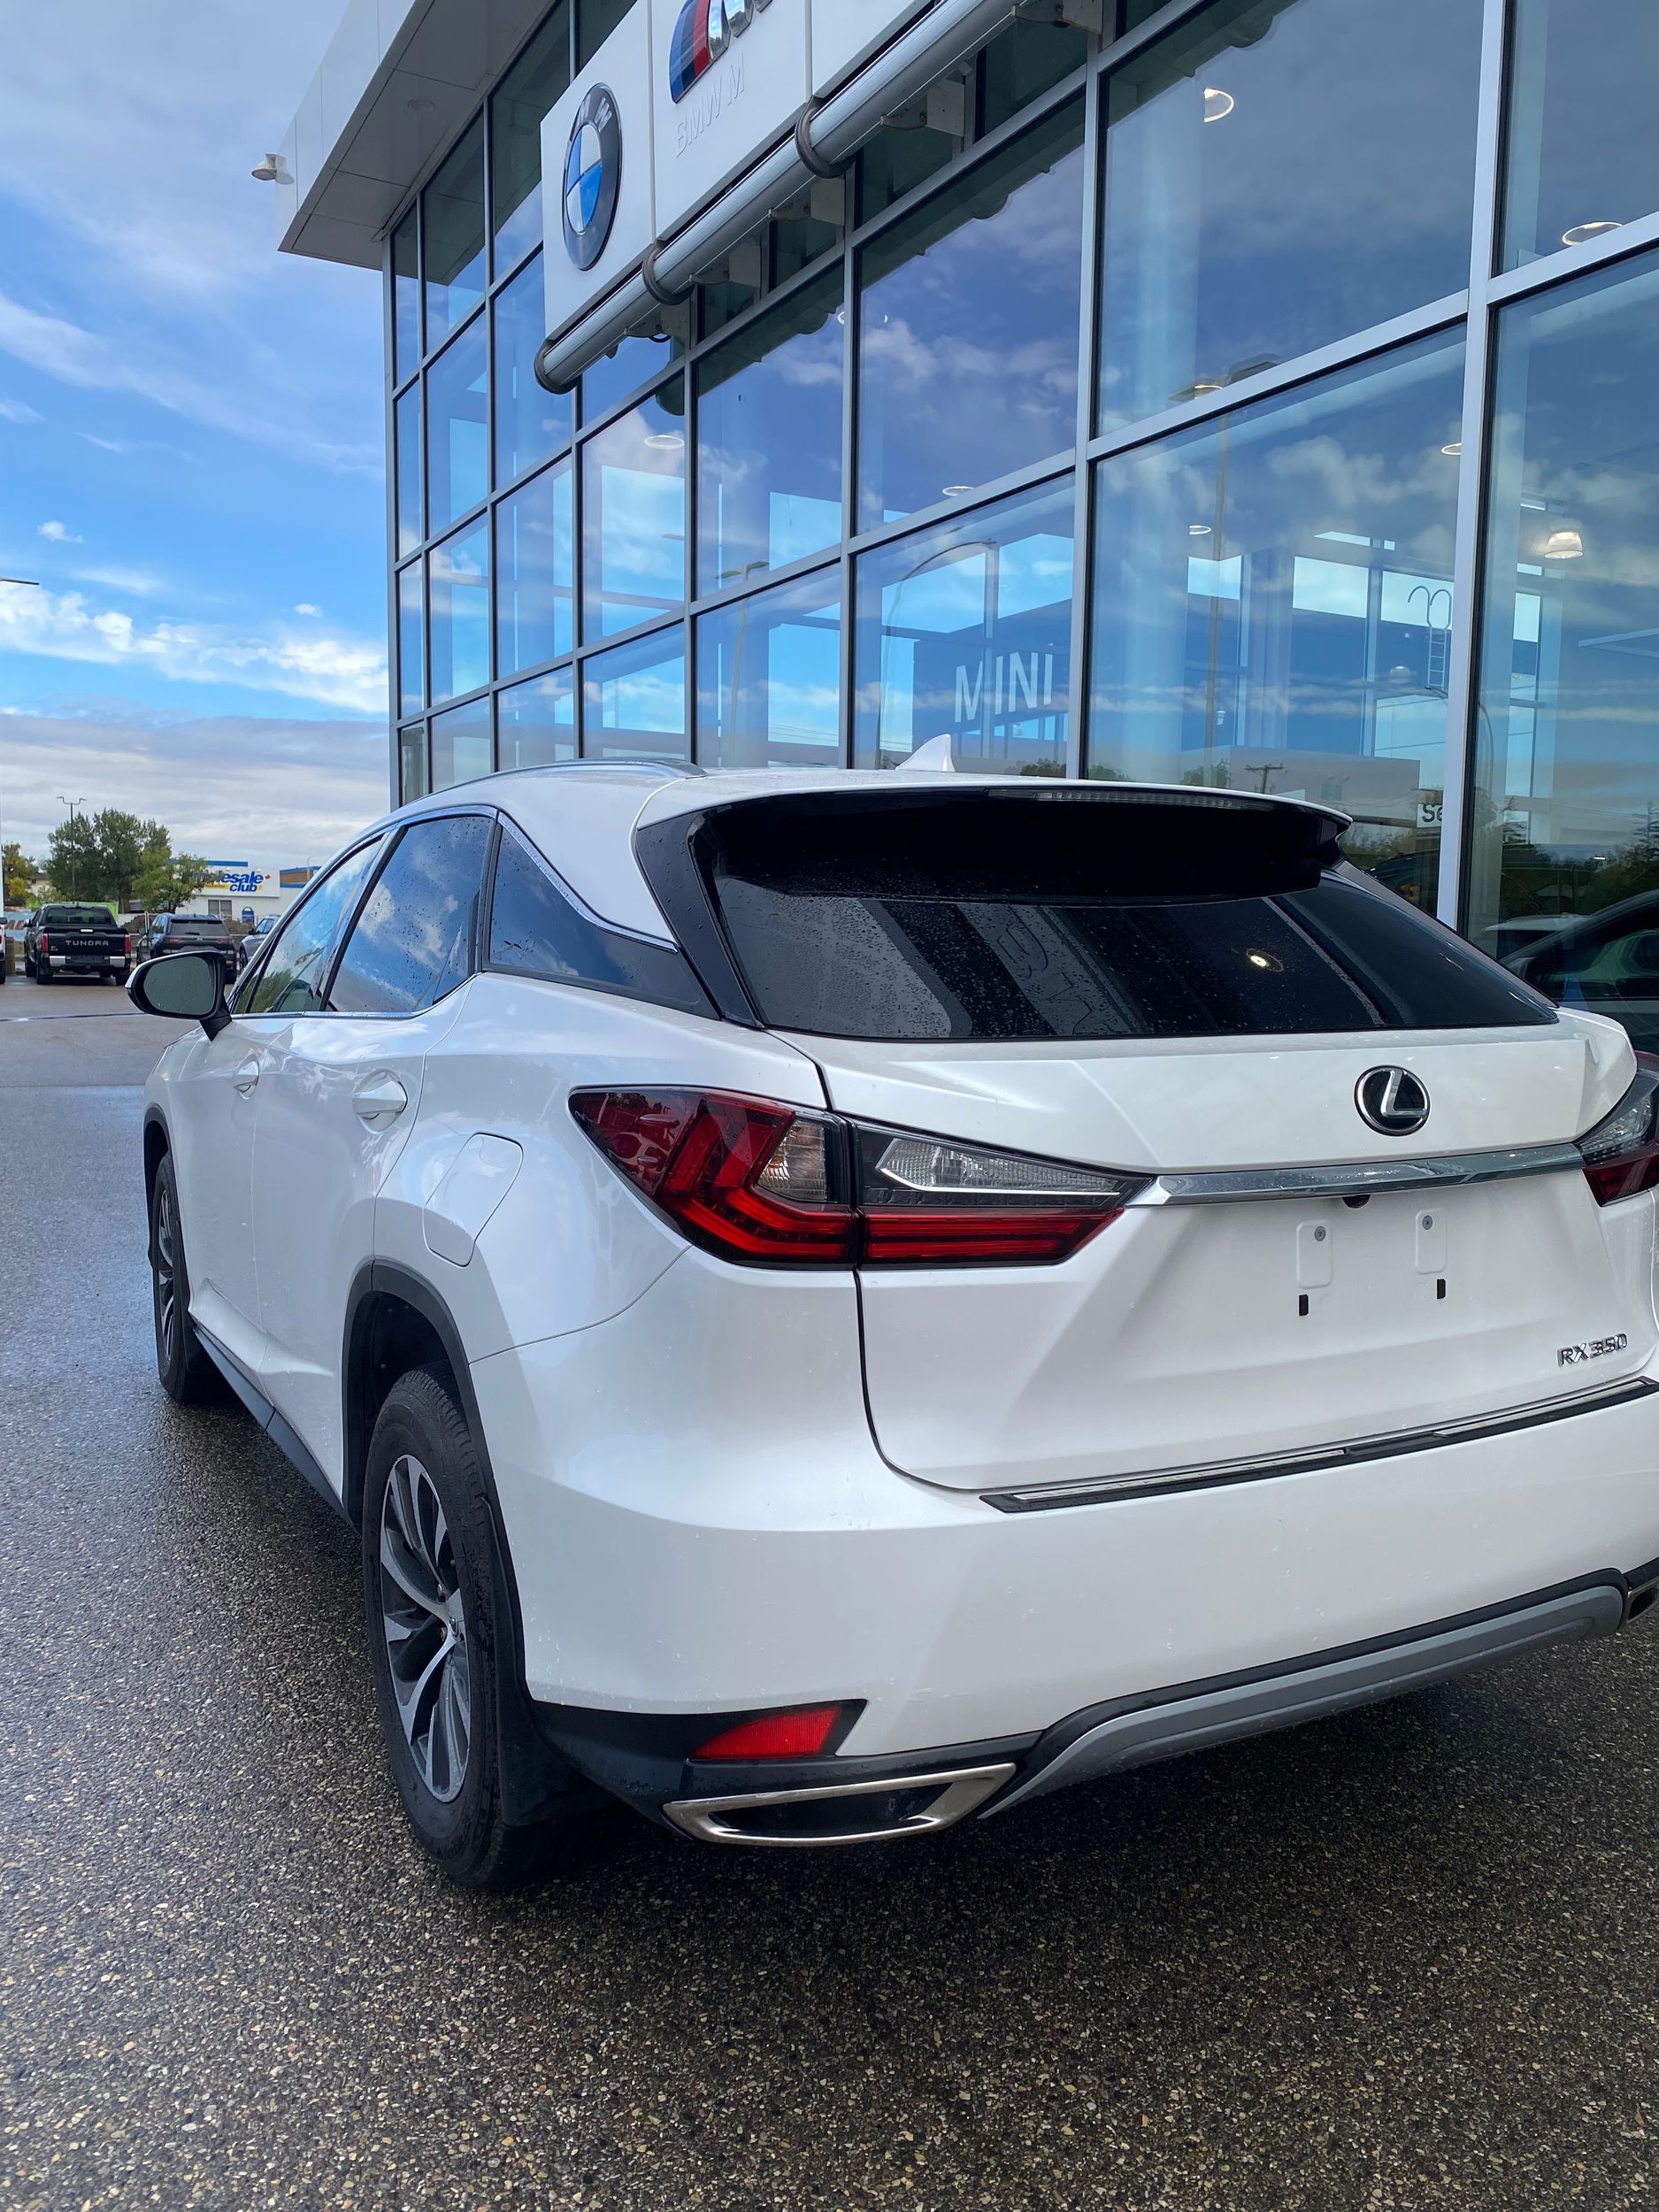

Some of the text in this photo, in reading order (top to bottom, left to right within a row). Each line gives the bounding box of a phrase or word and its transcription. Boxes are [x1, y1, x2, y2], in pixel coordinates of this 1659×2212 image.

[675, 74, 723, 158] BMW
[955, 651, 1054, 724] MINI
[229, 882, 258, 893] club
